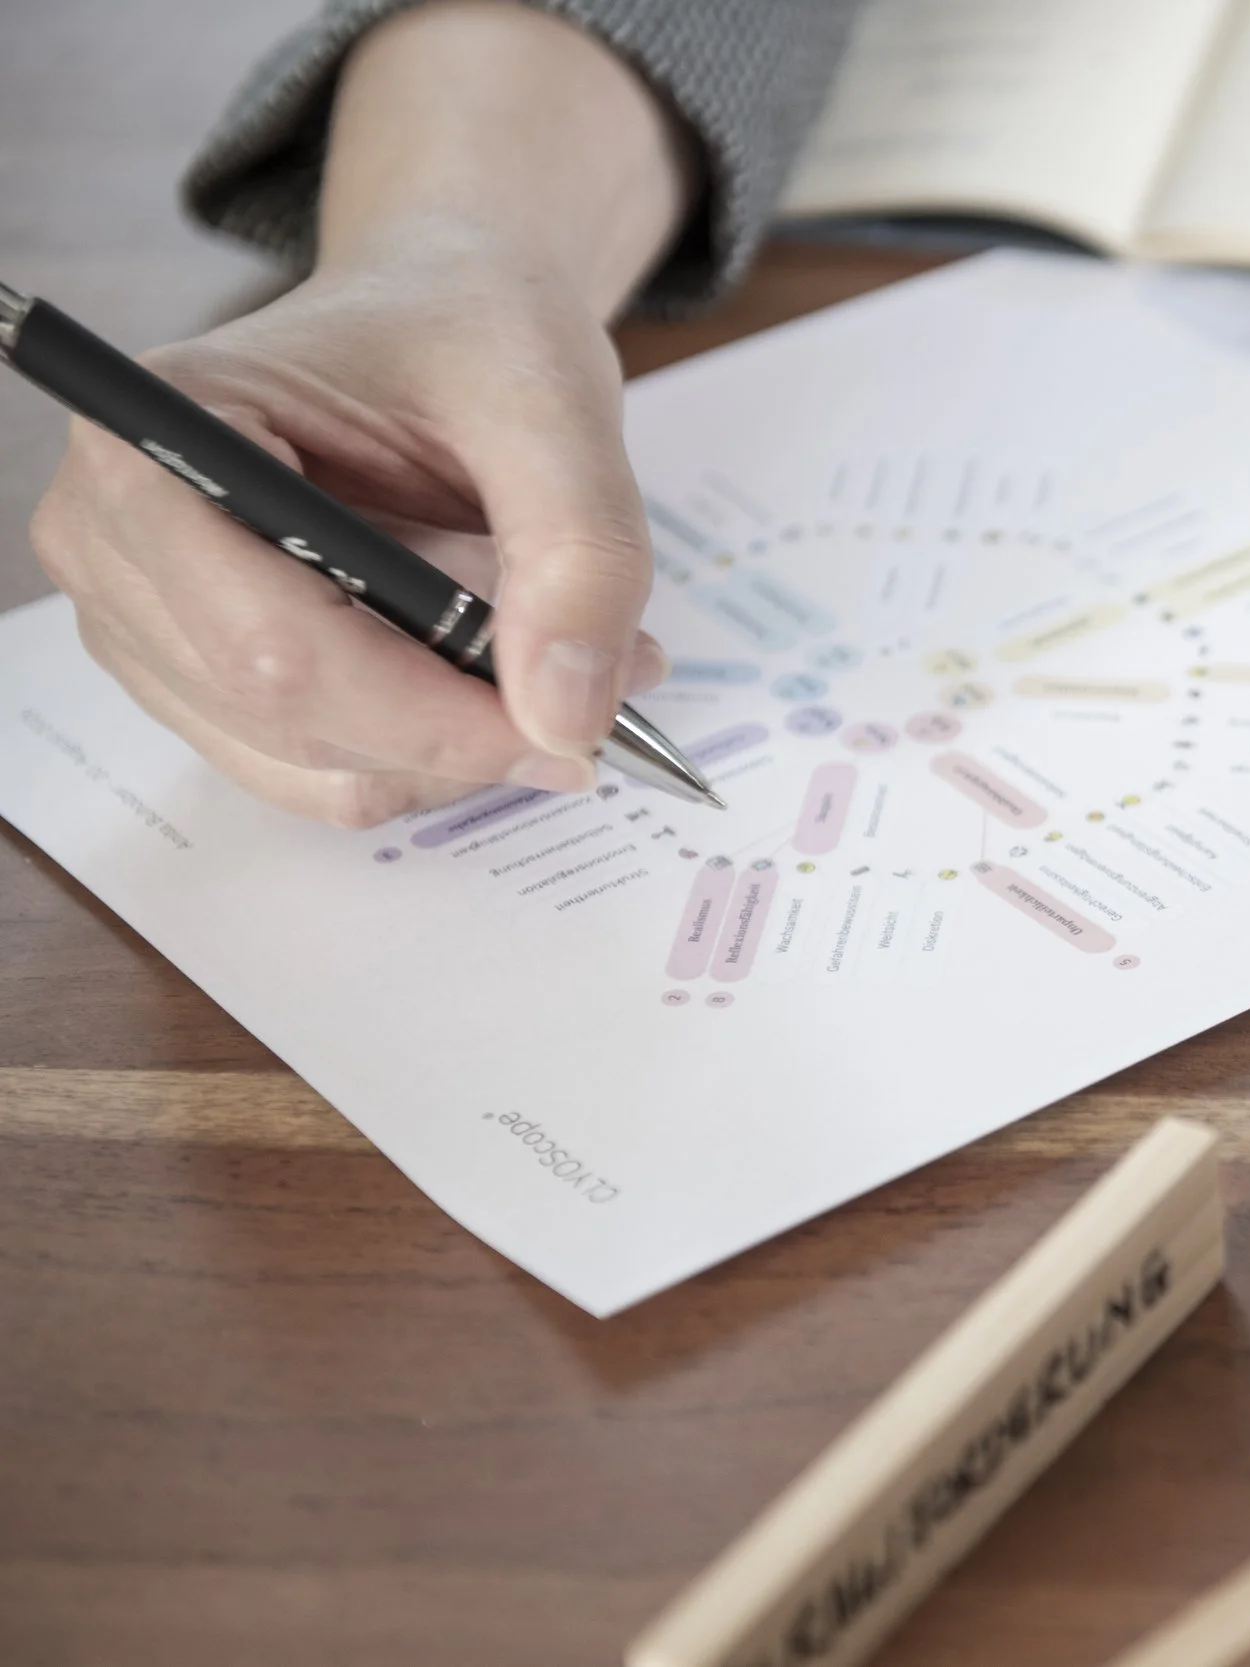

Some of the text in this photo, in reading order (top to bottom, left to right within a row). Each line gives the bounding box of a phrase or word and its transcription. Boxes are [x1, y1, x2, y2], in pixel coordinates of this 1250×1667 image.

[688, 897, 713, 944] Realismus
[725, 883, 761, 965] Reflexionsfähigkeit
[775, 897, 804, 955] Wachsamkeit
[826, 884, 863, 973] Gefahrenbewusstsein
[877, 910, 900, 950] Weitsicht
[922, 909, 945, 953] Diskretion
[1006, 882, 1084, 936] Unparteilichkeit
